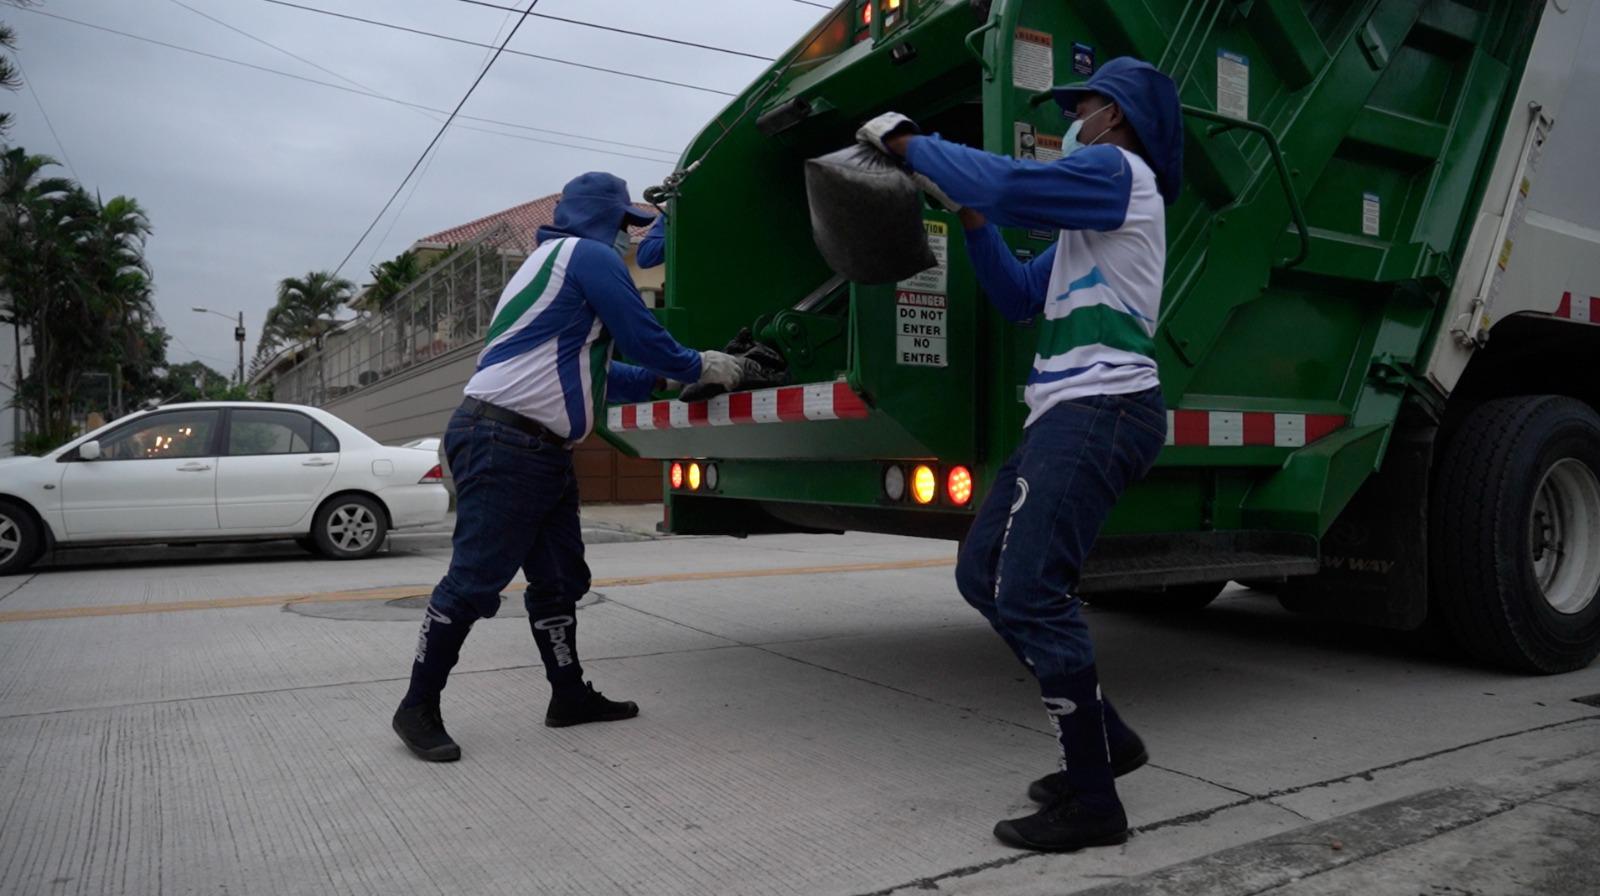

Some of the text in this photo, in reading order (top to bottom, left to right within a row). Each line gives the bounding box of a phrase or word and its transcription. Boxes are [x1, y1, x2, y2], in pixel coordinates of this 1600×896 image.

[926, 223, 944, 234] TION
[909, 293, 945, 307] DANGER
[900, 308, 943, 320] DO NOT
[903, 324, 941, 335] ENTER
[914, 338, 930, 348] NO
[903, 352, 941, 364] ENTRE
